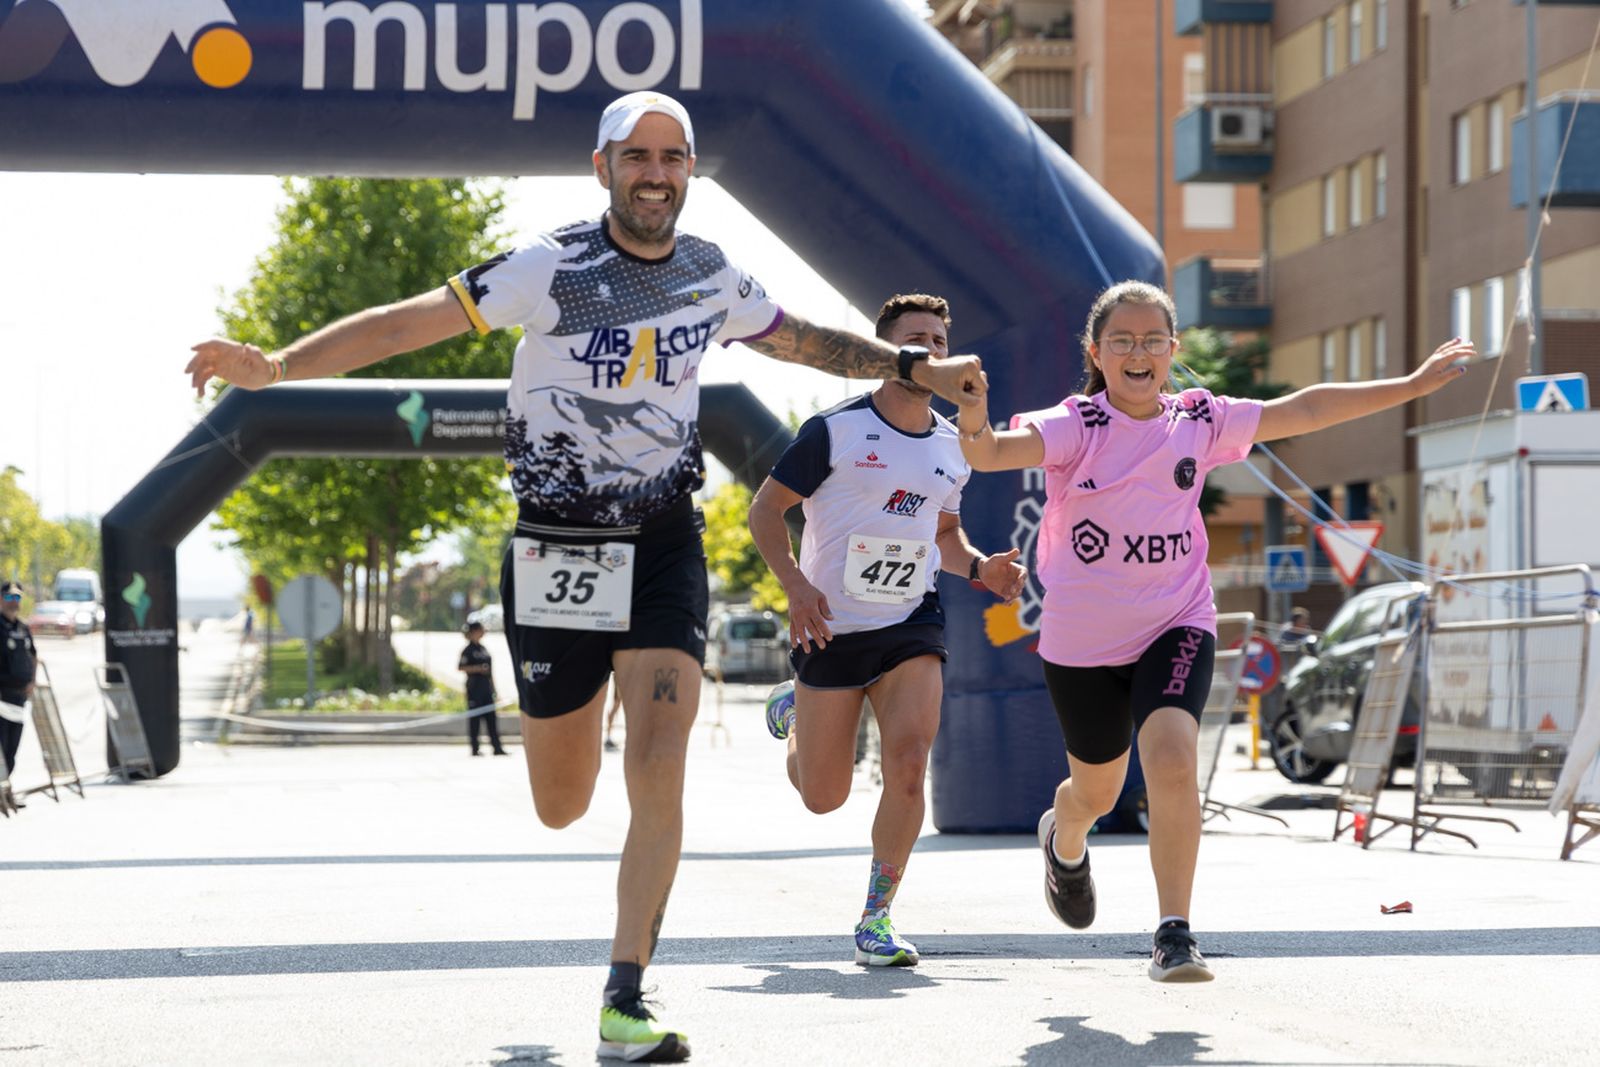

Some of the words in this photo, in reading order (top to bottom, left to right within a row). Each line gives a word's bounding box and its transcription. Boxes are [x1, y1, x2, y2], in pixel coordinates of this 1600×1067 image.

[302, 0, 702, 120] mupol
[570, 322, 711, 361] JABALCUZ
[585, 338, 675, 388] TRAIL
[433, 408, 497, 423] Patronato
[433, 422, 495, 439] Deportes
[855, 460, 888, 470] Santander
[1123, 530, 1192, 563] XBTU
[545, 569, 600, 604] 35
[860, 559, 916, 588] 472
[1162, 627, 1204, 696] bekki
